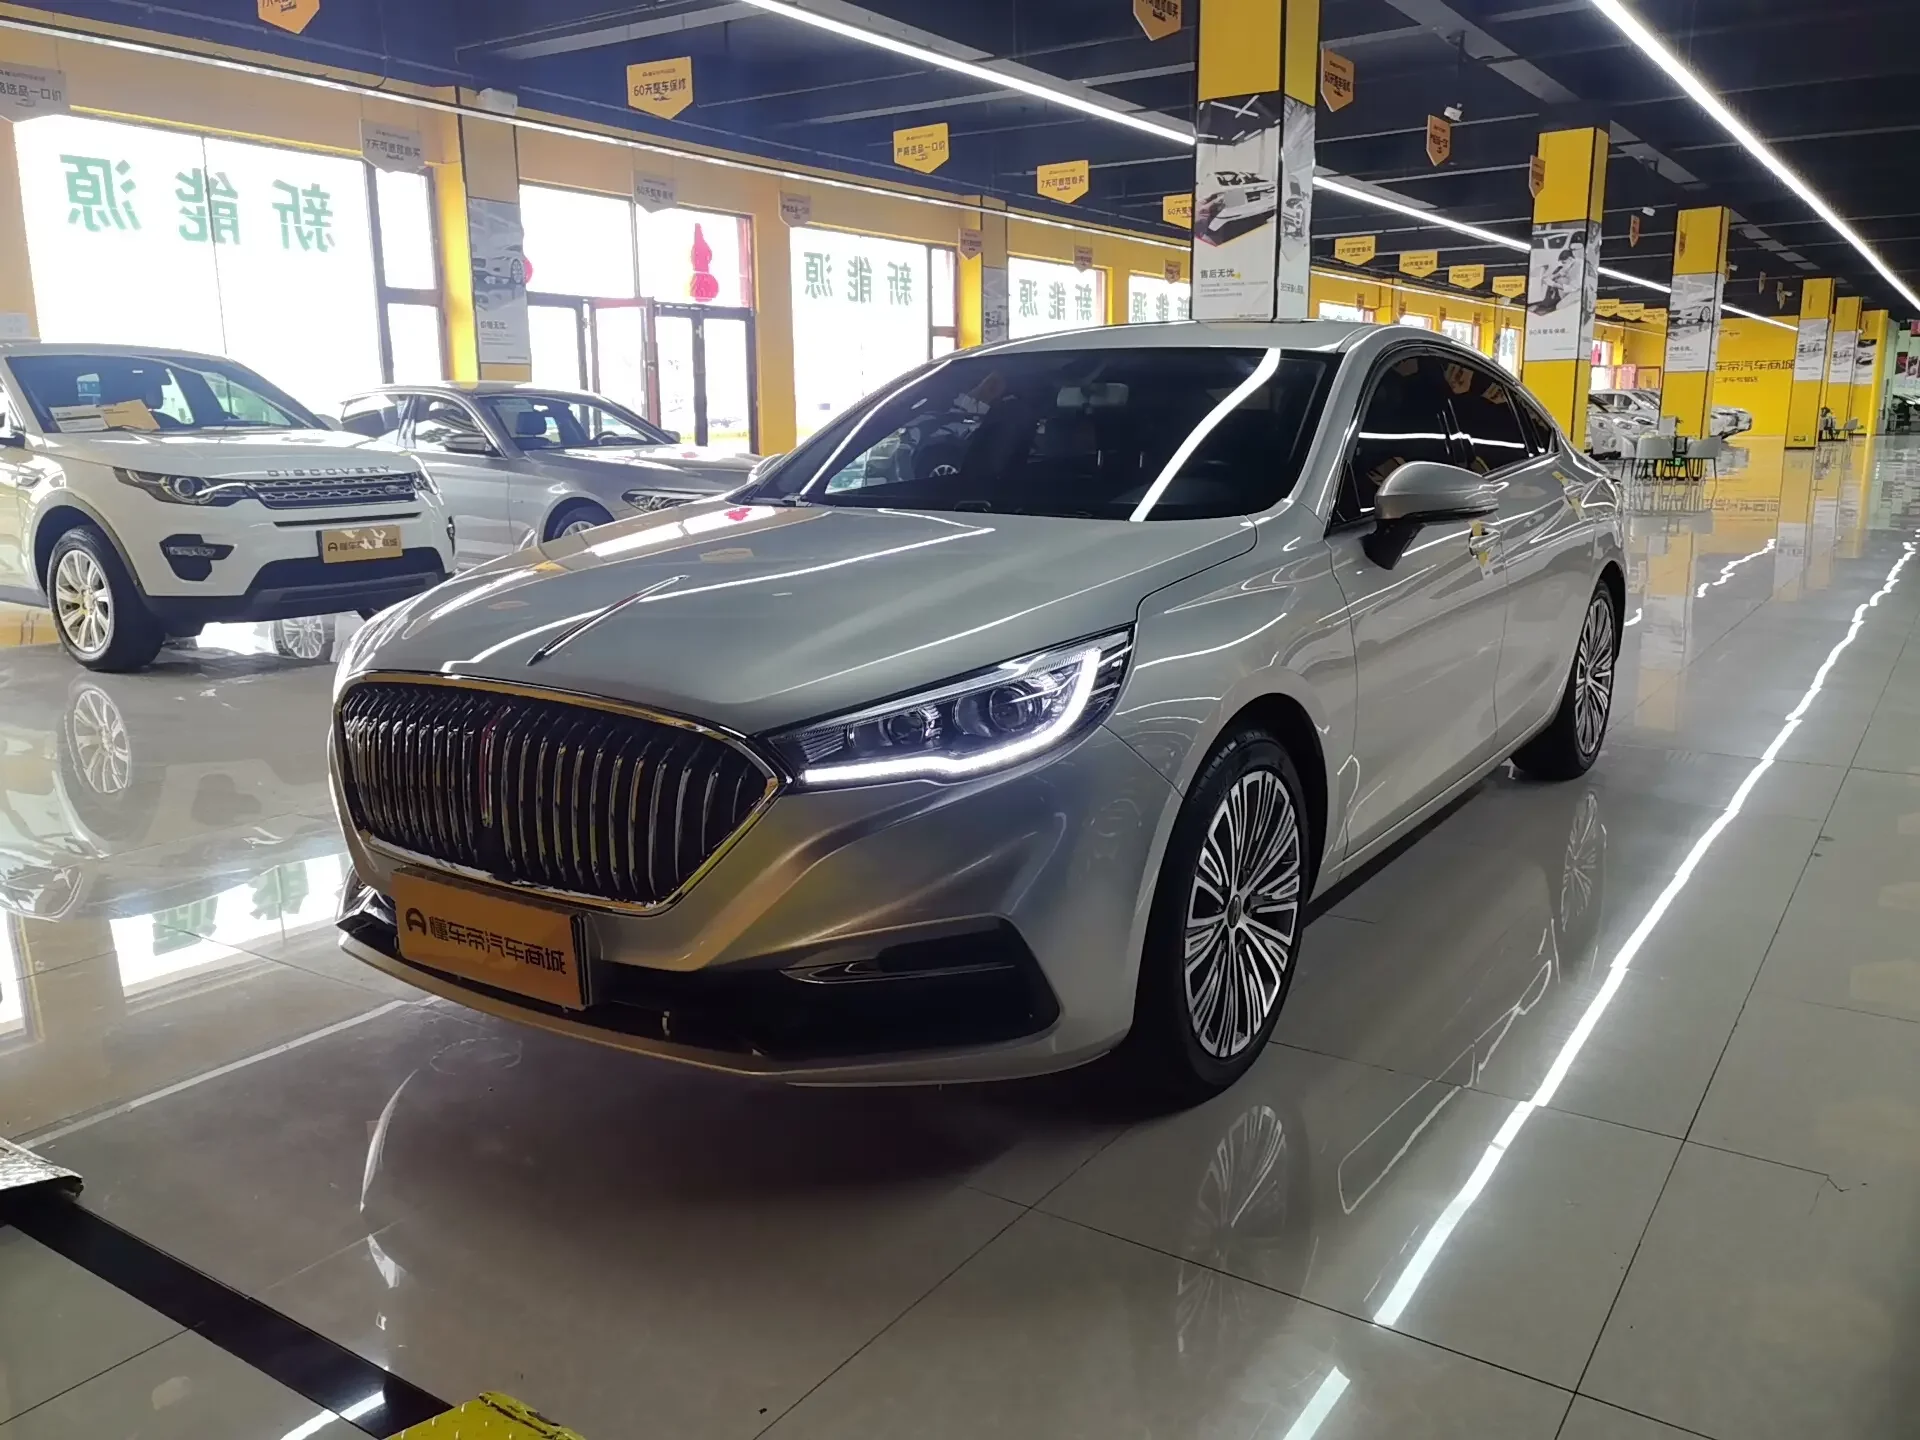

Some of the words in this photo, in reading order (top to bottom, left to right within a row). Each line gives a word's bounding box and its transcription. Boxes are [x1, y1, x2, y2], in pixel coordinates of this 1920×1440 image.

[1200, 265, 1236, 279] 售后无忧
[266, 465, 390, 478] DISCOVERY
[428, 915, 567, 975] 懂车帝汽车商城
